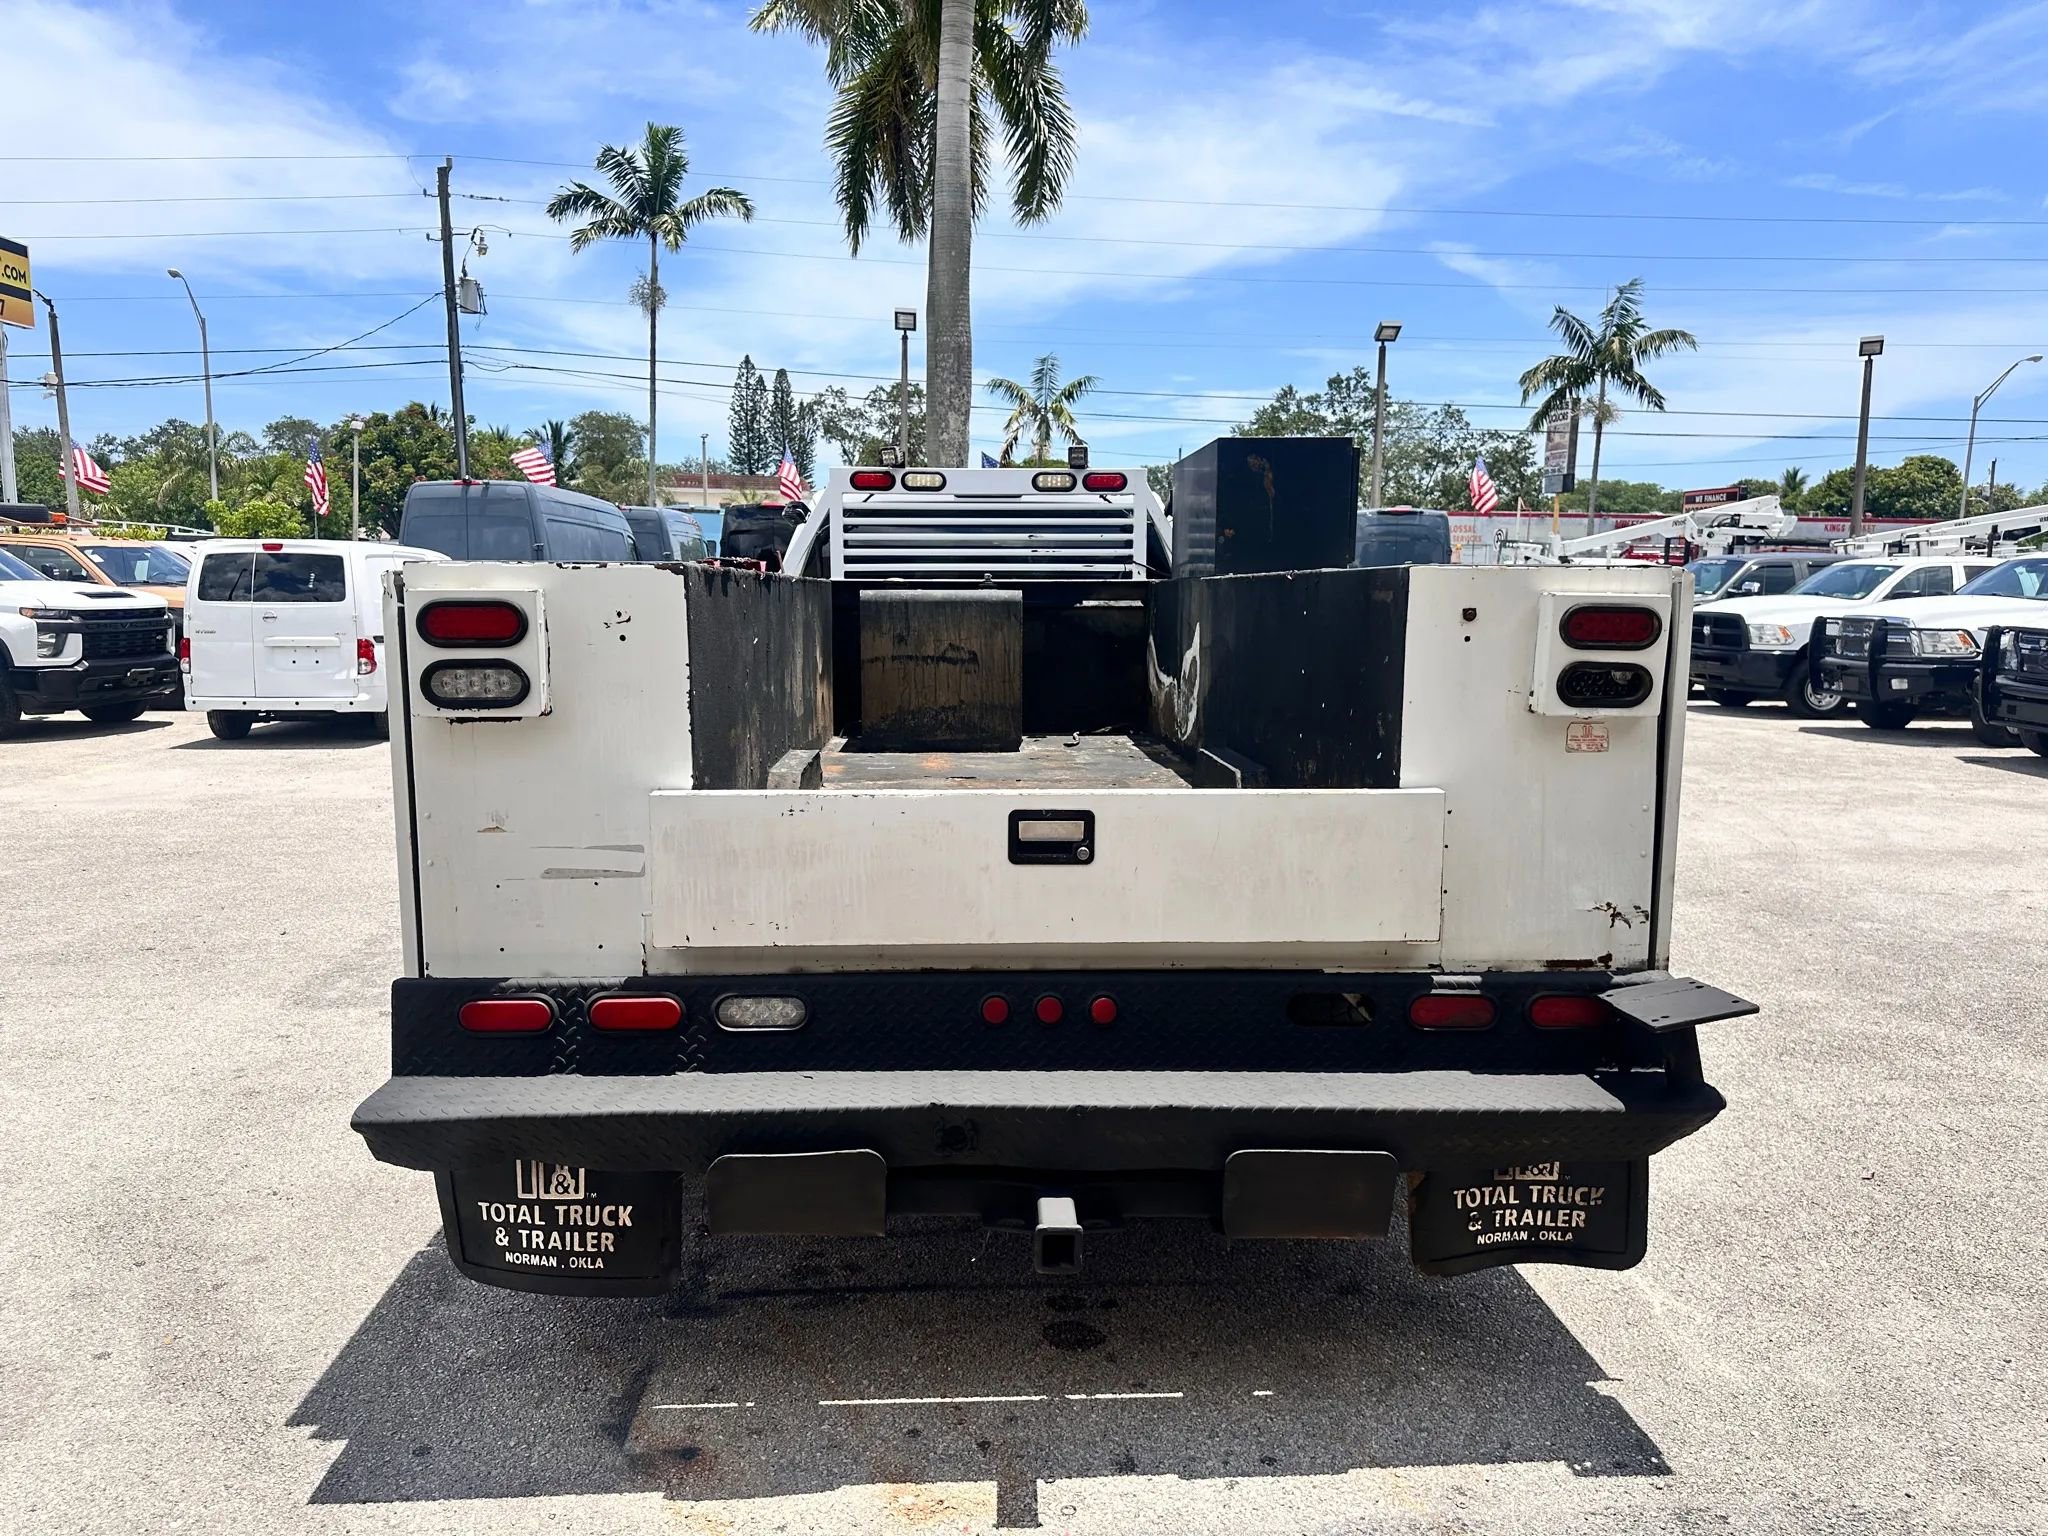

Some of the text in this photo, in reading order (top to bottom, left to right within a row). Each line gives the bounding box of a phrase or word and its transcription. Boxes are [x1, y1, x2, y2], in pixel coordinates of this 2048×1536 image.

[1, 264, 27, 284] .COM
[1704, 493, 1727, 502] FINANCE
[1824, 524, 1846, 533] KINGS
[1453, 1185, 1605, 1210] TOTAL TRUCK
[477, 1202, 633, 1227] TOTAL TRUCK
[1493, 1209, 1587, 1229] TRAILER
[495, 1227, 615, 1252] & TRAILER
[1477, 1231, 1529, 1245] NORMAN
[1539, 1230, 1574, 1242] OKLA
[505, 1251, 557, 1268] NORMAN
[569, 1256, 604, 1269] OKLA
